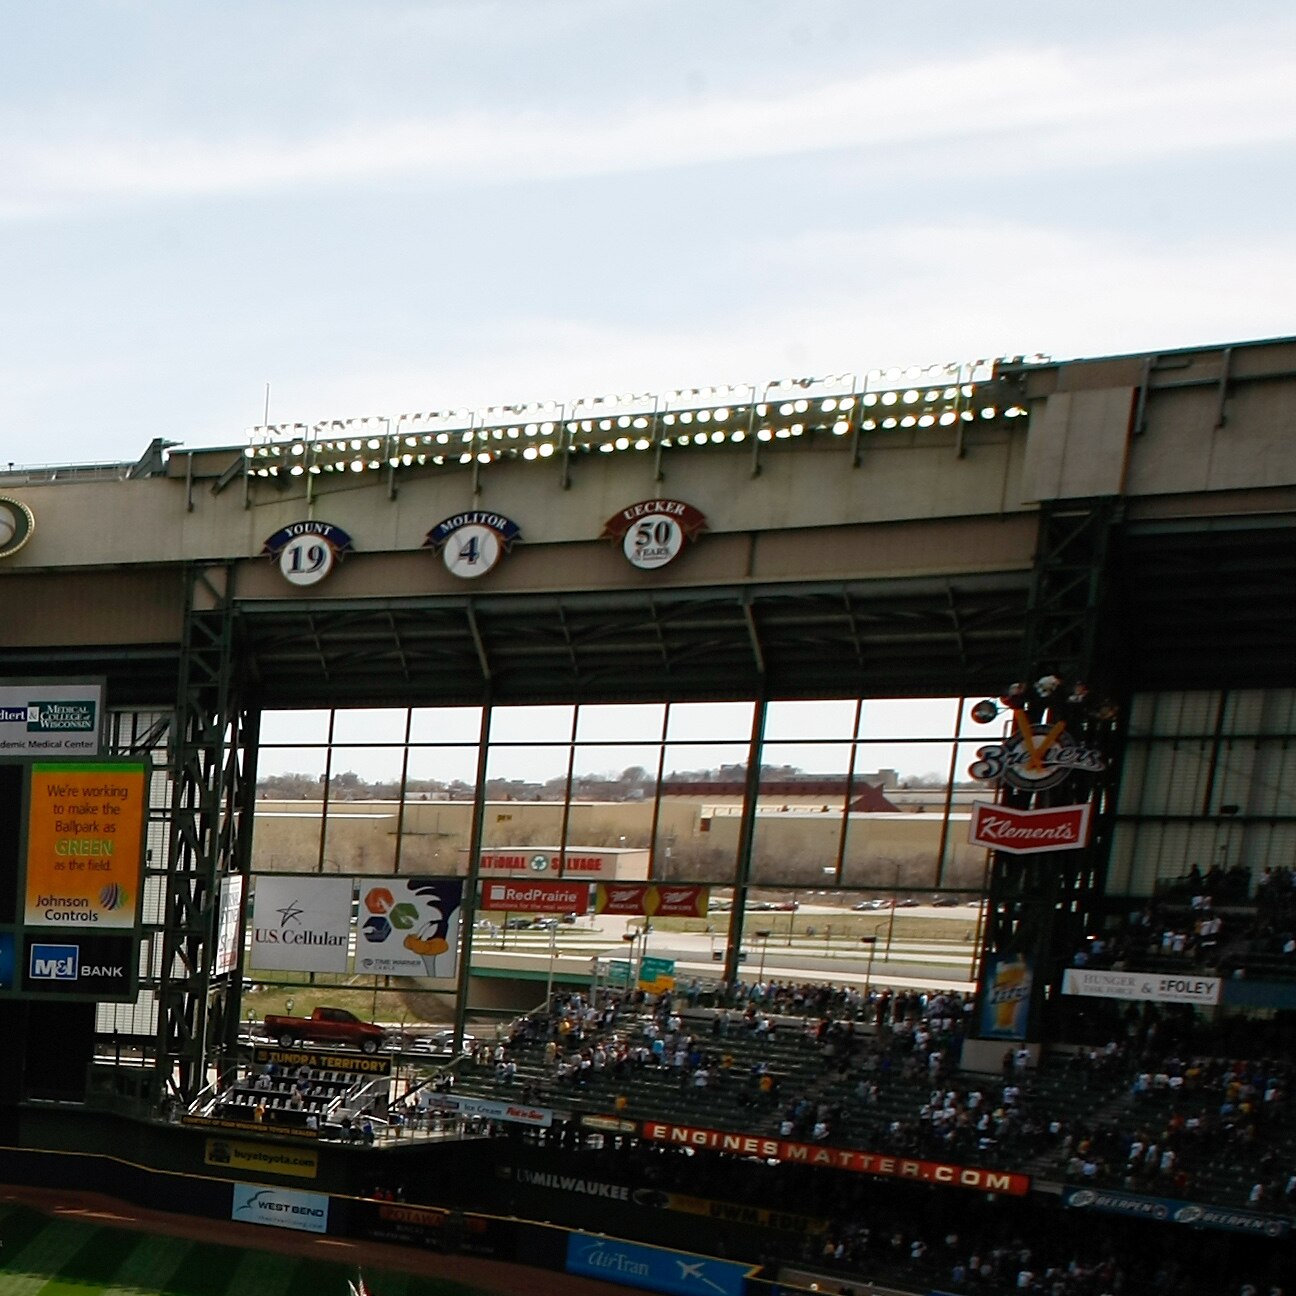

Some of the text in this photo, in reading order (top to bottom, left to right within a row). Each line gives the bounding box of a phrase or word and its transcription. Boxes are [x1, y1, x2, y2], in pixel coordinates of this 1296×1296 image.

[622, 501, 687, 521] UECKER
[284, 522, 333, 538] YOUNT
[440, 512, 508, 533] MOLITOR
[635, 520, 672, 547] 50
[458, 536, 479, 565] 4
[287, 545, 325, 574] 19
[40, 711, 80, 721] COLLEGE
[47, 704, 89, 713] MEDICAL
[40, 719, 93, 729] WISCONSIN
[28, 741, 62, 749] Medical
[64, 741, 94, 749] Center
[47, 785, 129, 801] We're working
[53, 803, 121, 816] to make the
[55, 820, 117, 834] Ballpark as
[979, 815, 1077, 842] Klement's
[55, 840, 113, 857] GREEN
[54, 862, 65, 871] as
[69, 859, 85, 871] the
[36, 895, 89, 909] Johnson
[506, 888, 577, 903] RedPrairie
[44, 909, 99, 922] Controls
[282, 929, 347, 946] Cellular
[80, 965, 124, 978] BANK
[1083, 973, 1215, 995] HUNGER & FOLEY
[269, 1050, 388, 1072] TUNDRA TERRITORY
[258, 1201, 324, 1218] WEST BEND
[587, 1248, 650, 1277] AirTran
